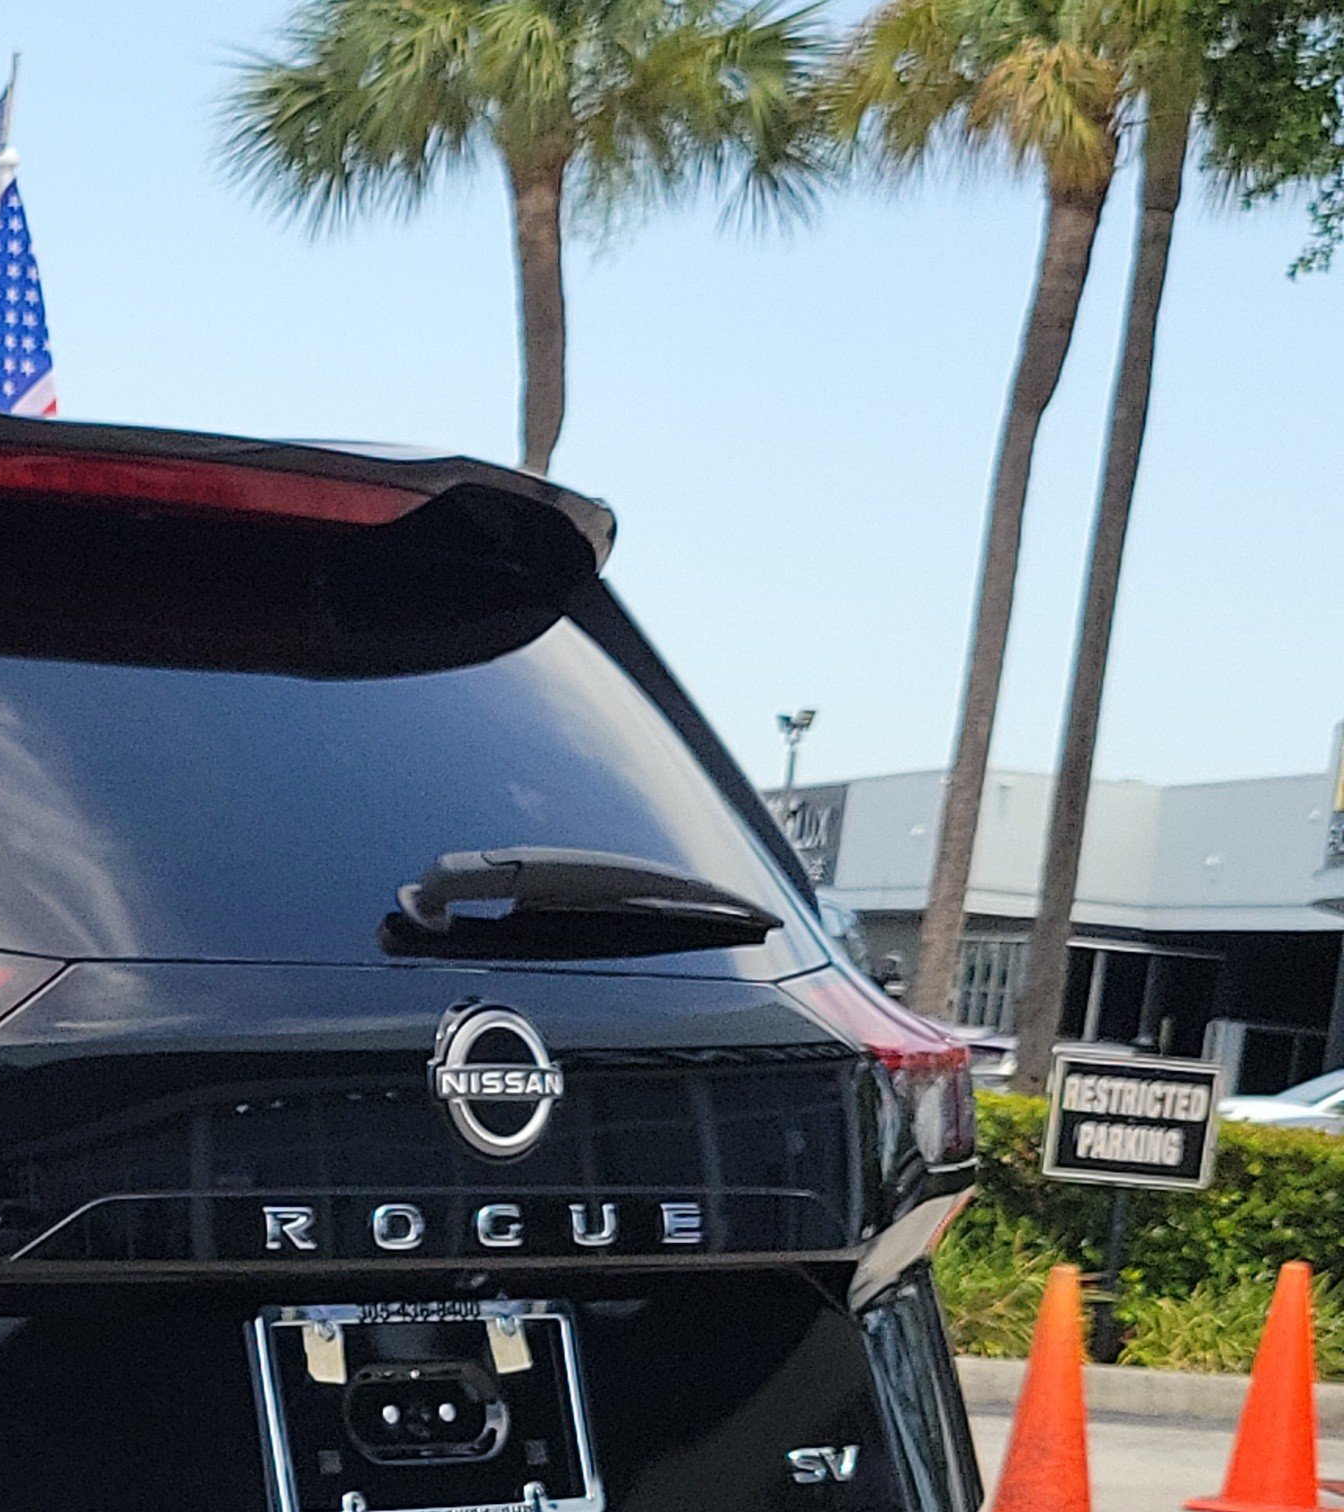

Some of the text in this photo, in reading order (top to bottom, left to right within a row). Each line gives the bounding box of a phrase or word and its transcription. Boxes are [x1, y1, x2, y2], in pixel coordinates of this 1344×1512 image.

[441, 1070, 561, 1095] NISSAN
[1063, 1073, 1210, 1122] RESTRICTED
[1075, 1120, 1185, 1166] PARKING
[261, 1202, 705, 1251] ROGUE
[786, 1444, 861, 1484] SV
